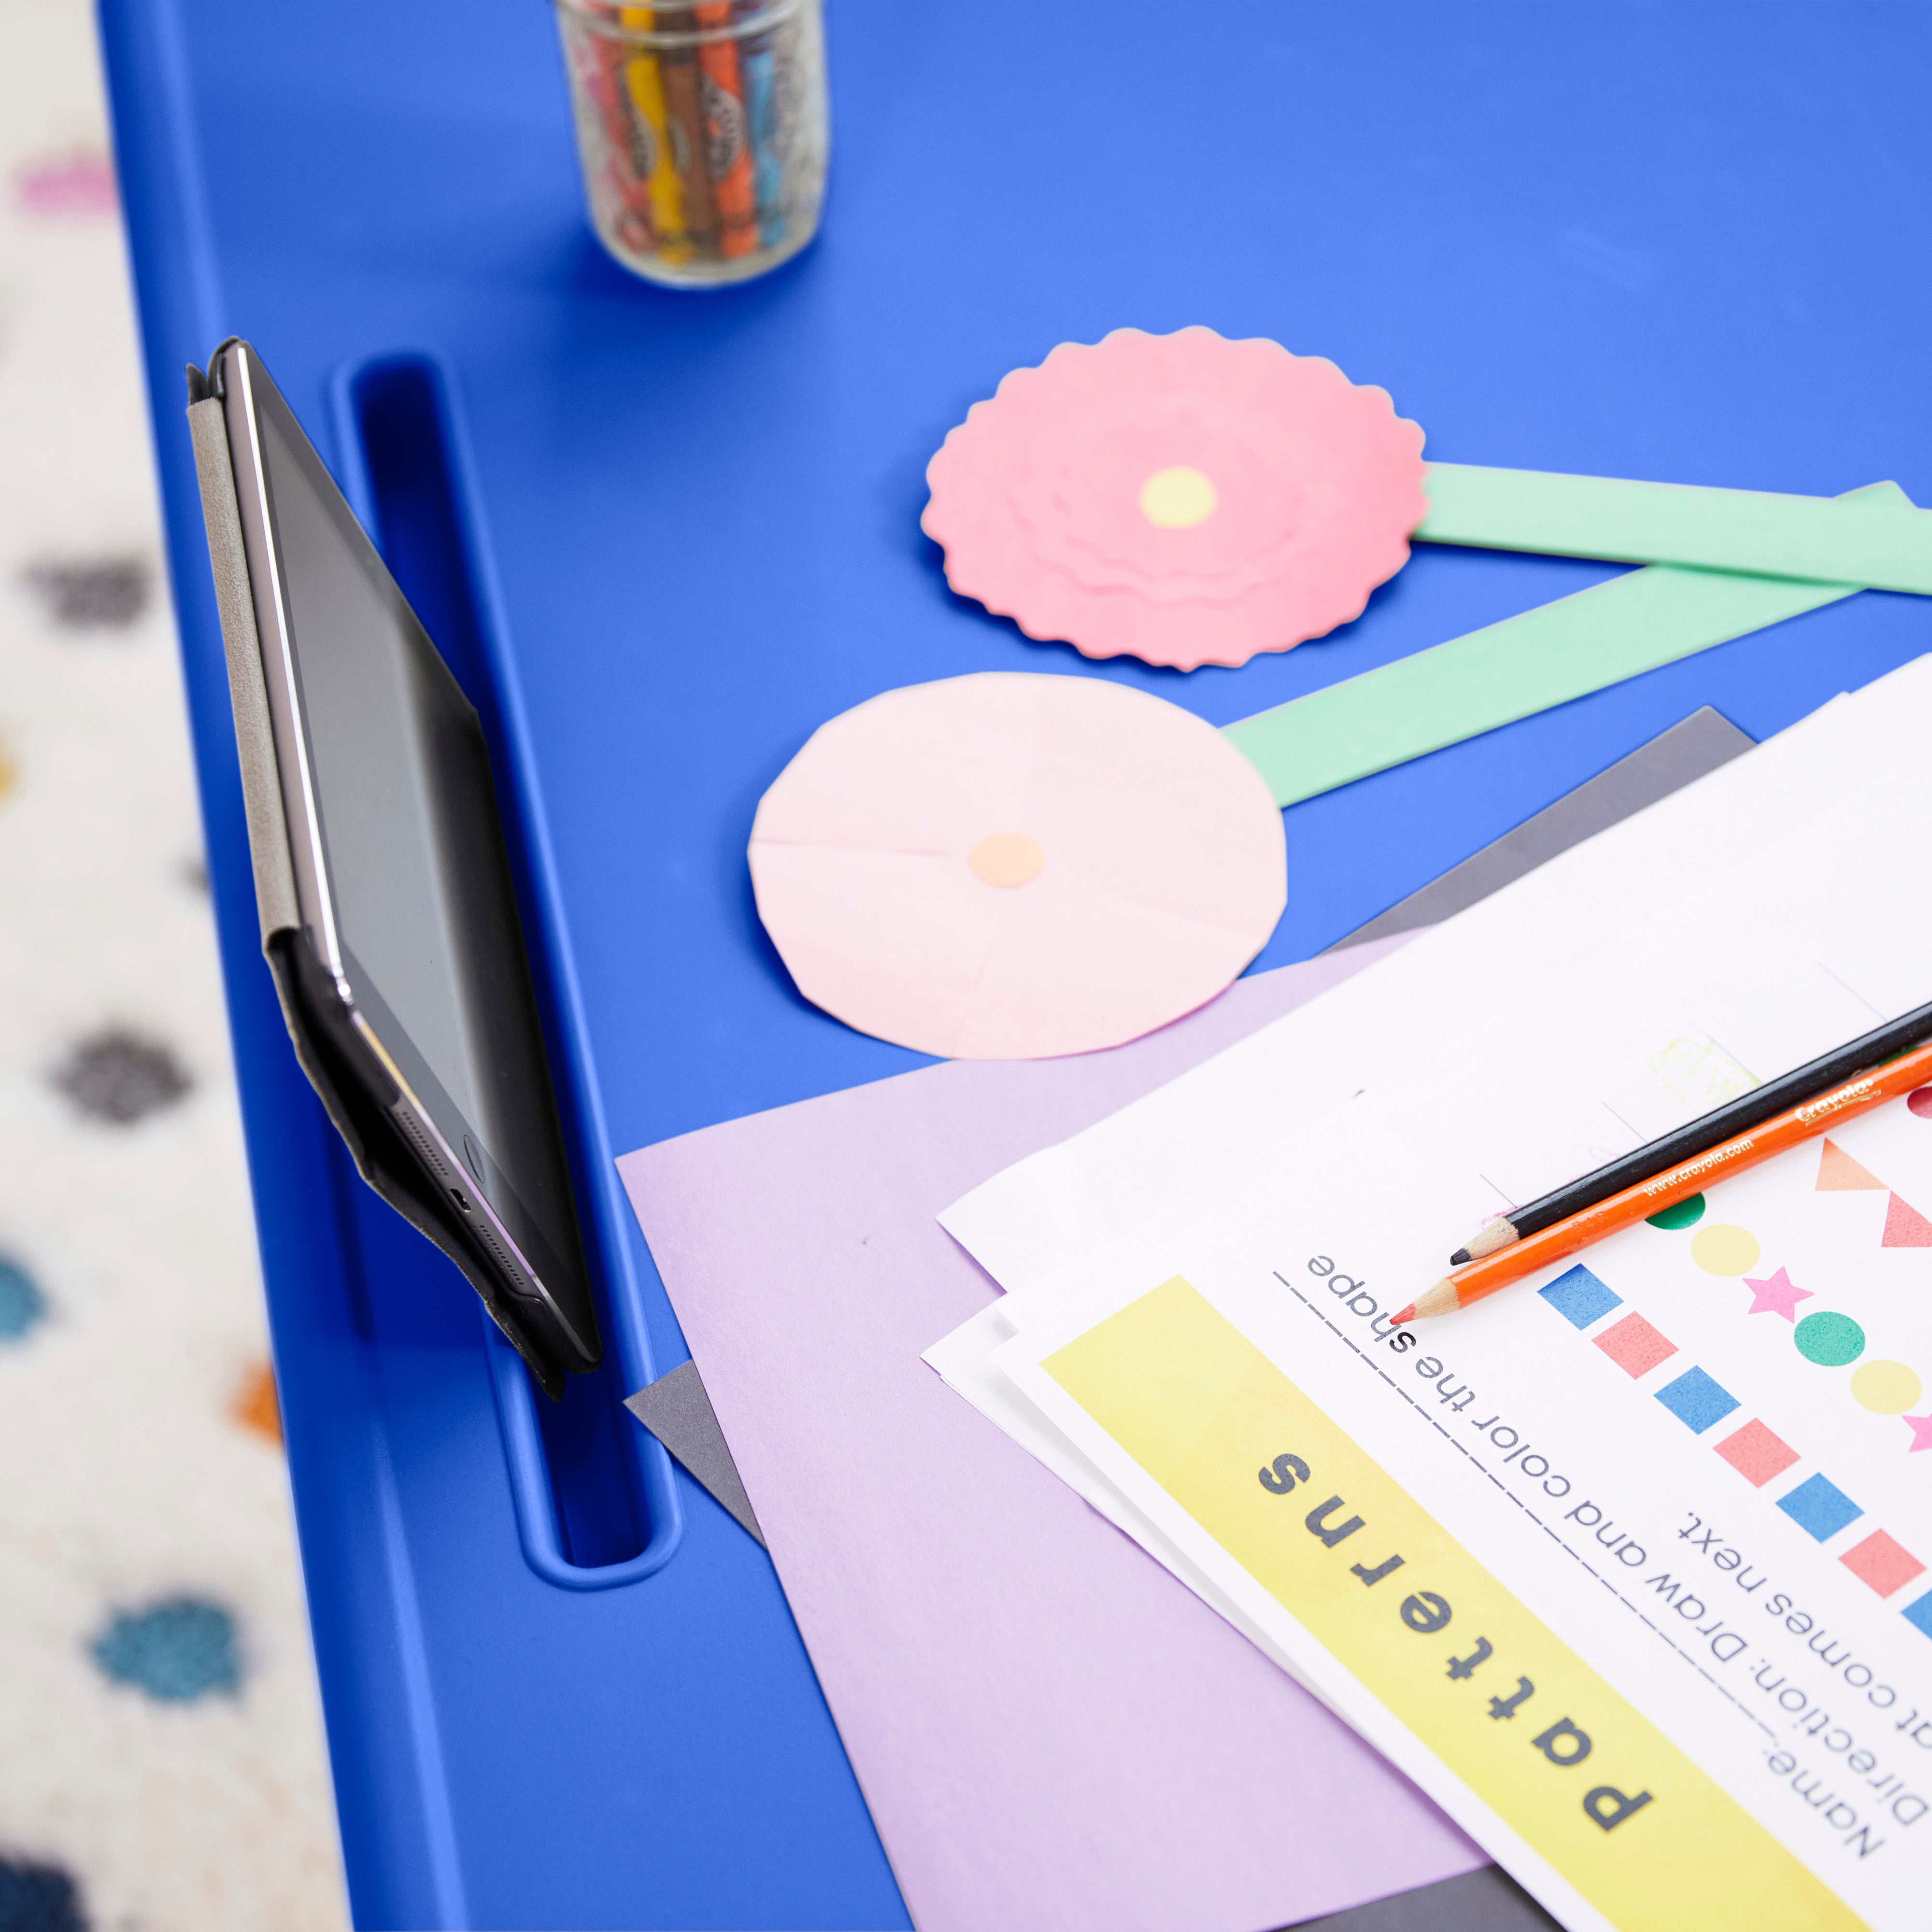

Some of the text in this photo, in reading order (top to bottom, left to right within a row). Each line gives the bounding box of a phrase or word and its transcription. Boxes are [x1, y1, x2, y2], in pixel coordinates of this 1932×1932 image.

[1643, 1139, 1754, 1196] www.crayola.com
[1307, 1255, 1930, 1826] Direction: Draw and color the shape
[1678, 1512, 1767, 1593] next.
[1258, 1453, 1655, 1834] Patterns
[1765, 1593, 1896, 1708] comes
[1762, 1742, 1885, 1859] Name:
